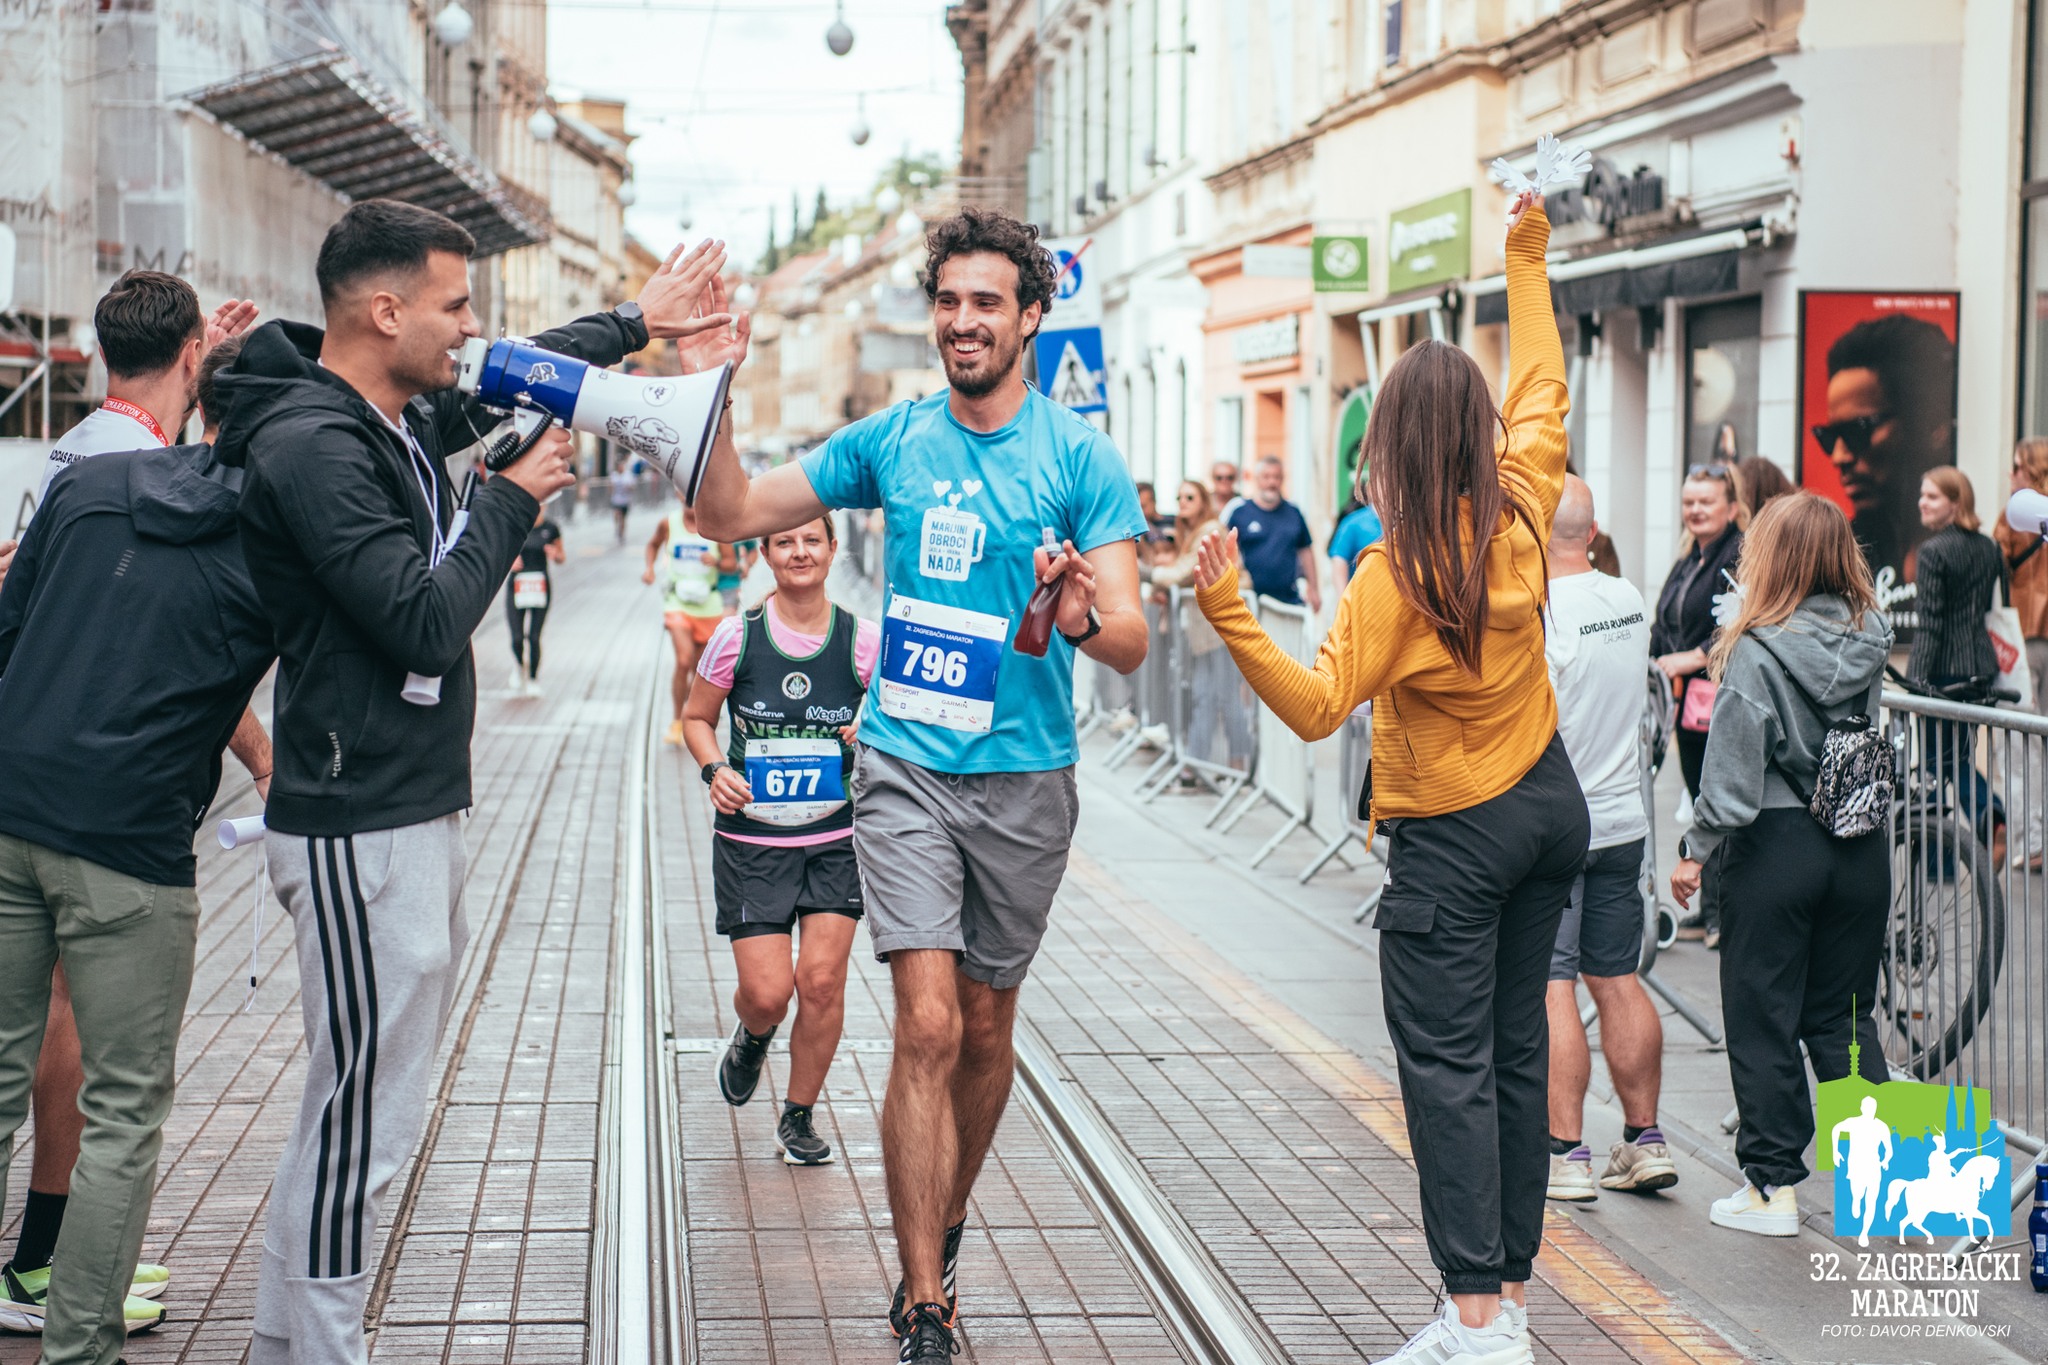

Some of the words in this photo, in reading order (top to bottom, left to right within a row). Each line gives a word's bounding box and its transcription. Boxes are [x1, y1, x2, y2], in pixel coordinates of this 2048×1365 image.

[929, 533, 966, 549] OBROCI
[927, 554, 962, 573] NADA
[1579, 620, 1610, 636] ADIDAS
[1610, 612, 1644, 629] RUNNERS
[946, 633, 974, 644] MARATON
[1603, 629, 1631, 644] ZAGREB
[902, 640, 968, 687] 796
[886, 684, 919, 696] INTERSPORT
[739, 704, 785, 718] VERDESATIVA
[941, 699, 968, 708] GARMIN
[328, 732, 341, 771] CLIMAHEAT
[765, 769, 821, 797] 677
